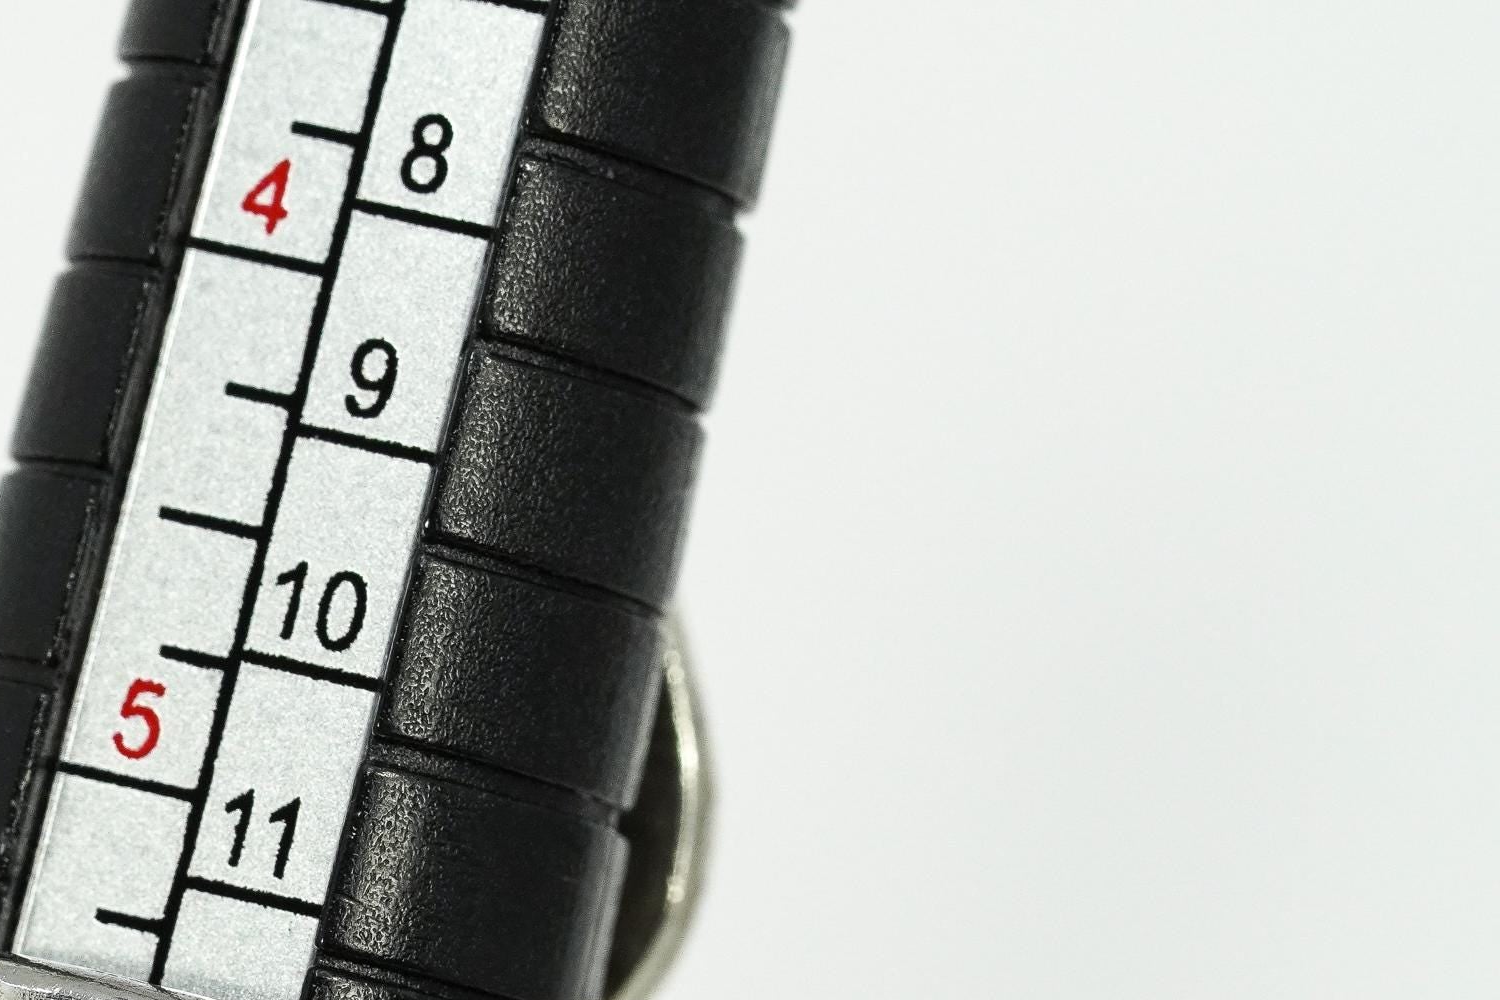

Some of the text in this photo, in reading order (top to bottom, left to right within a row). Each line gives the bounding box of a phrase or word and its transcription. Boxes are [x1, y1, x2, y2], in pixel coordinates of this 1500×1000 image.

[400, 113, 454, 195] 8
[242, 159, 292, 235] 4
[344, 337, 399, 420] 9
[275, 560, 368, 654] 10
[112, 678, 166, 761] 5
[224, 788, 302, 880] 11
